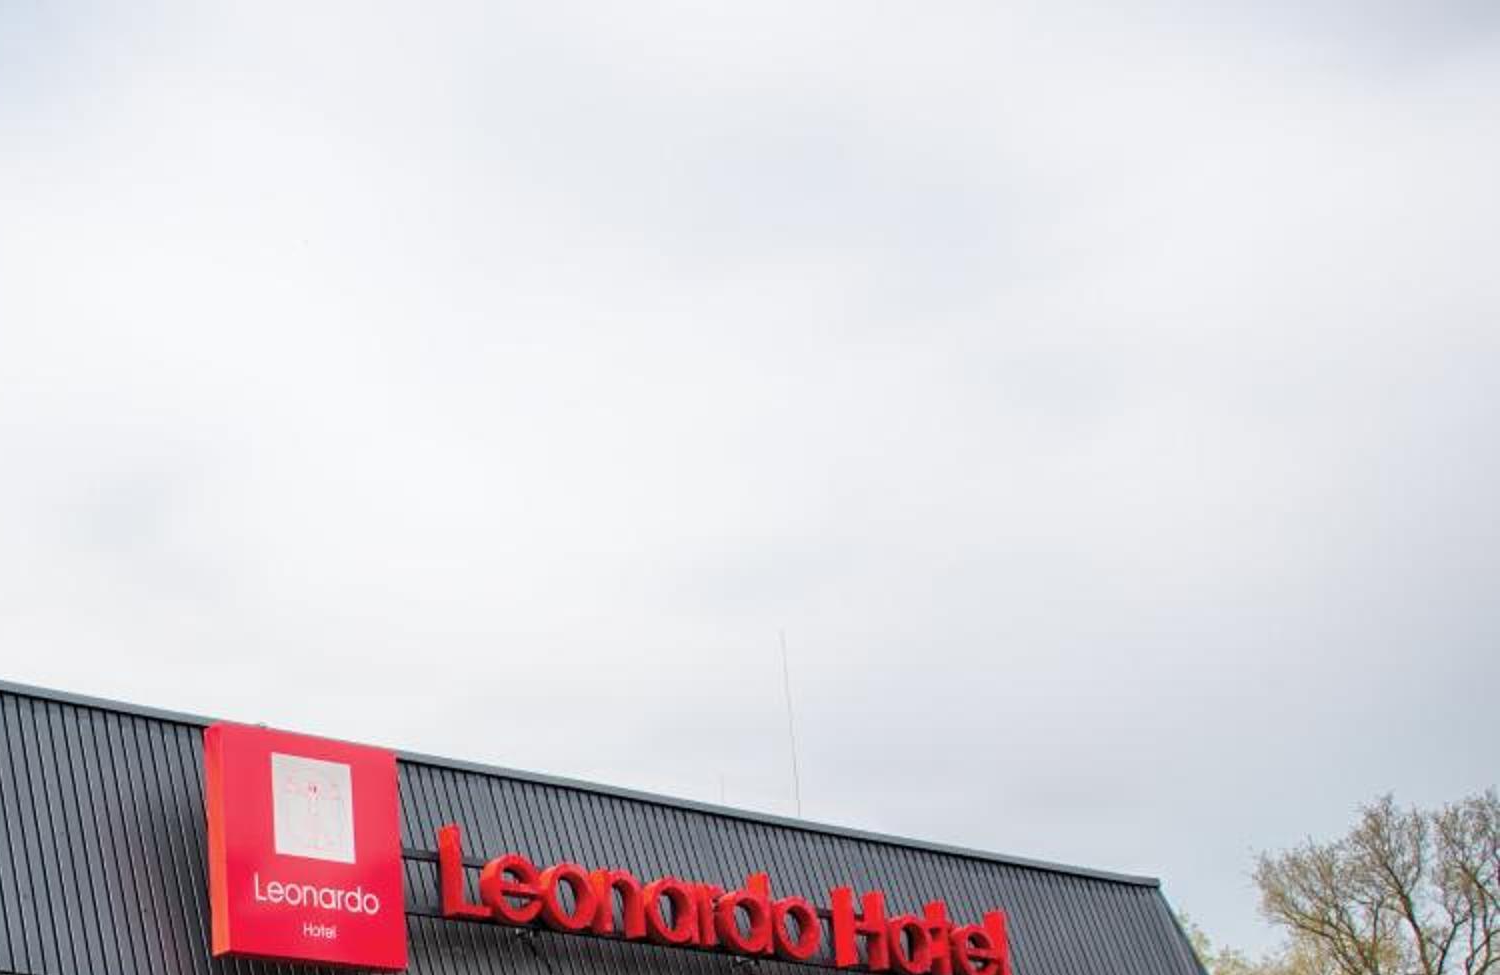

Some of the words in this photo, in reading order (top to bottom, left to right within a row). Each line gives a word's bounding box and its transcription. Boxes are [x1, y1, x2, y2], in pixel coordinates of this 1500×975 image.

[253, 871, 381, 915] Leonardo
[437, 823, 822, 961] Leonardo
[303, 922, 337, 938] Hotel
